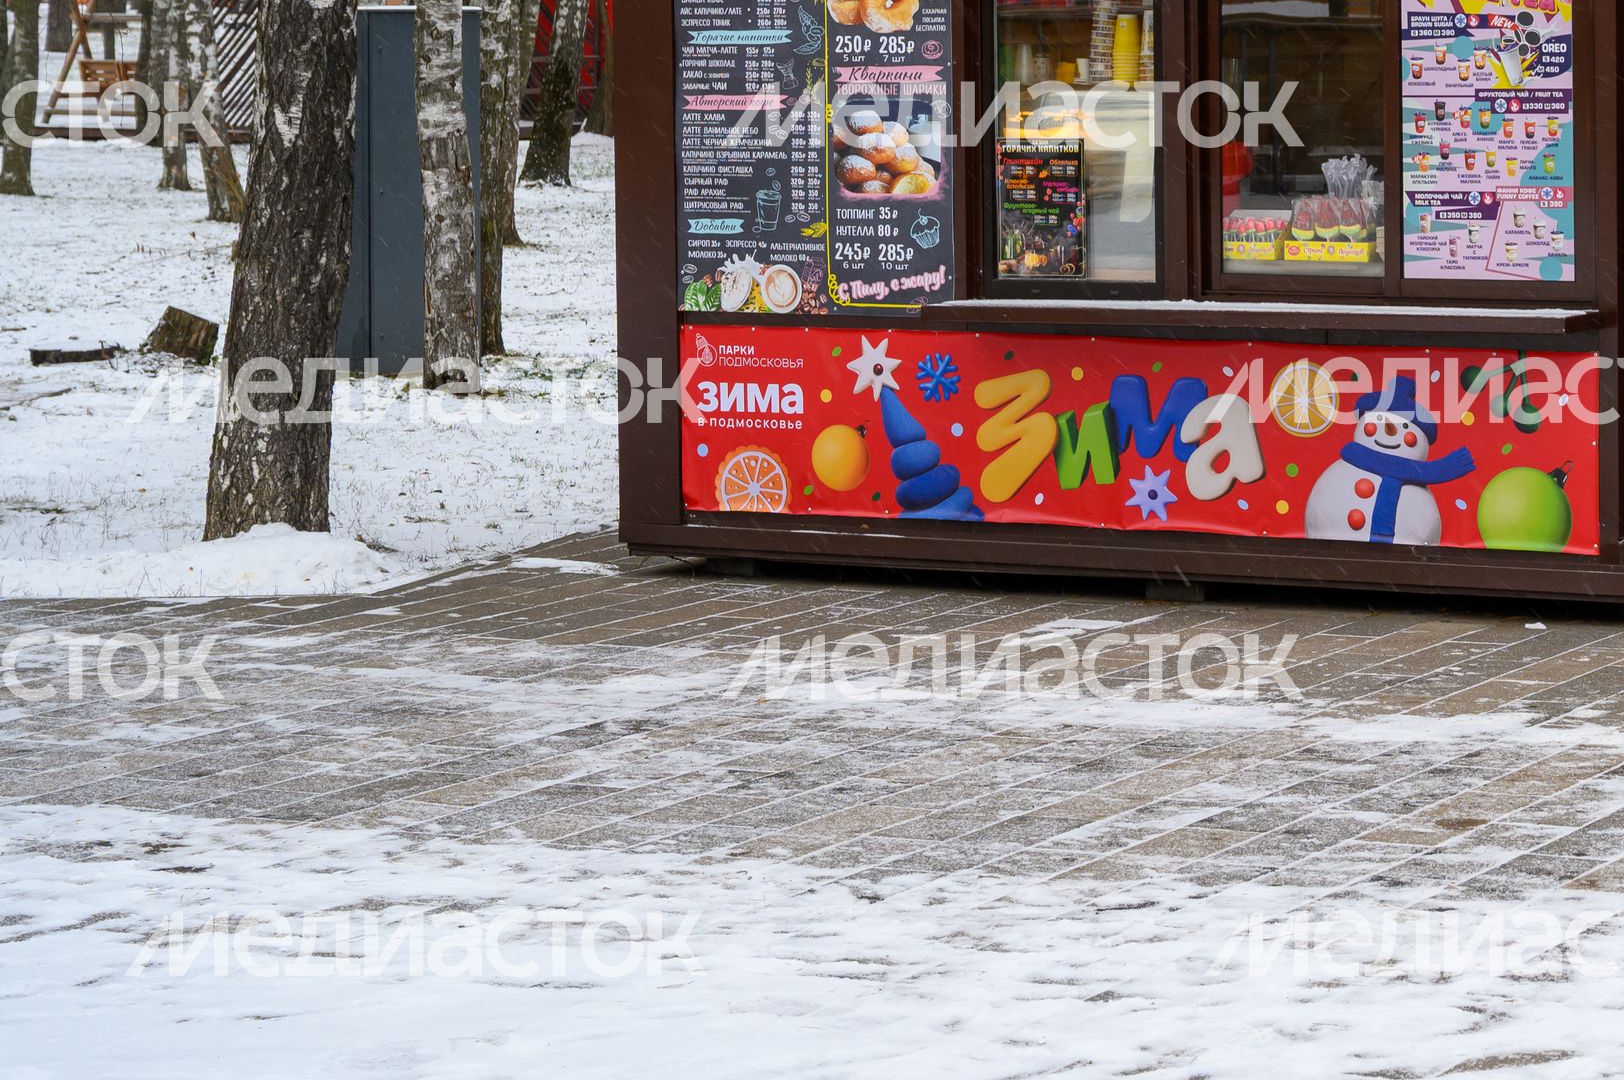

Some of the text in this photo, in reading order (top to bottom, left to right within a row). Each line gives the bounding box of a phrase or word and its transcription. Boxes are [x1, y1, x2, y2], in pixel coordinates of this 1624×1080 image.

[1491, 16, 1514, 29] NEW
[915, 24, 946, 32] БЕСПЛАТНО
[682, 46, 738, 54] ЧАЙ МАТЧА-ЛАТТЕ
[1542, 43, 1567, 53] OREO
[708, 59, 736, 68] ШОКОЛАД
[836, 84, 946, 95] ТВОРОЖНЫЕ ШАРИКИ
[1039, 145, 1079, 153] НАПИТКОВ
[752, 151, 787, 159] КАРАМЕЛЬ
[684, 188, 726, 196] РАФ АРАХИС
[684, 201, 728, 210] ЦИТРУСОВЫЙ
[836, 208, 875, 219] ТОППИНГ
[879, 207, 890, 219] 35
[836, 226, 874, 236] НУТЕЛЛА
[878, 225, 890, 237] 80
[725, 240, 757, 248] ЭСПРЕССО
[770, 243, 825, 251] АЛЬТЕРНАТИВНОЕ
[688, 251, 717, 259] МОЛОКО
[719, 345, 755, 355] ПАРКИ
[719, 357, 804, 368] ПОДМОСКОВЬЯ
